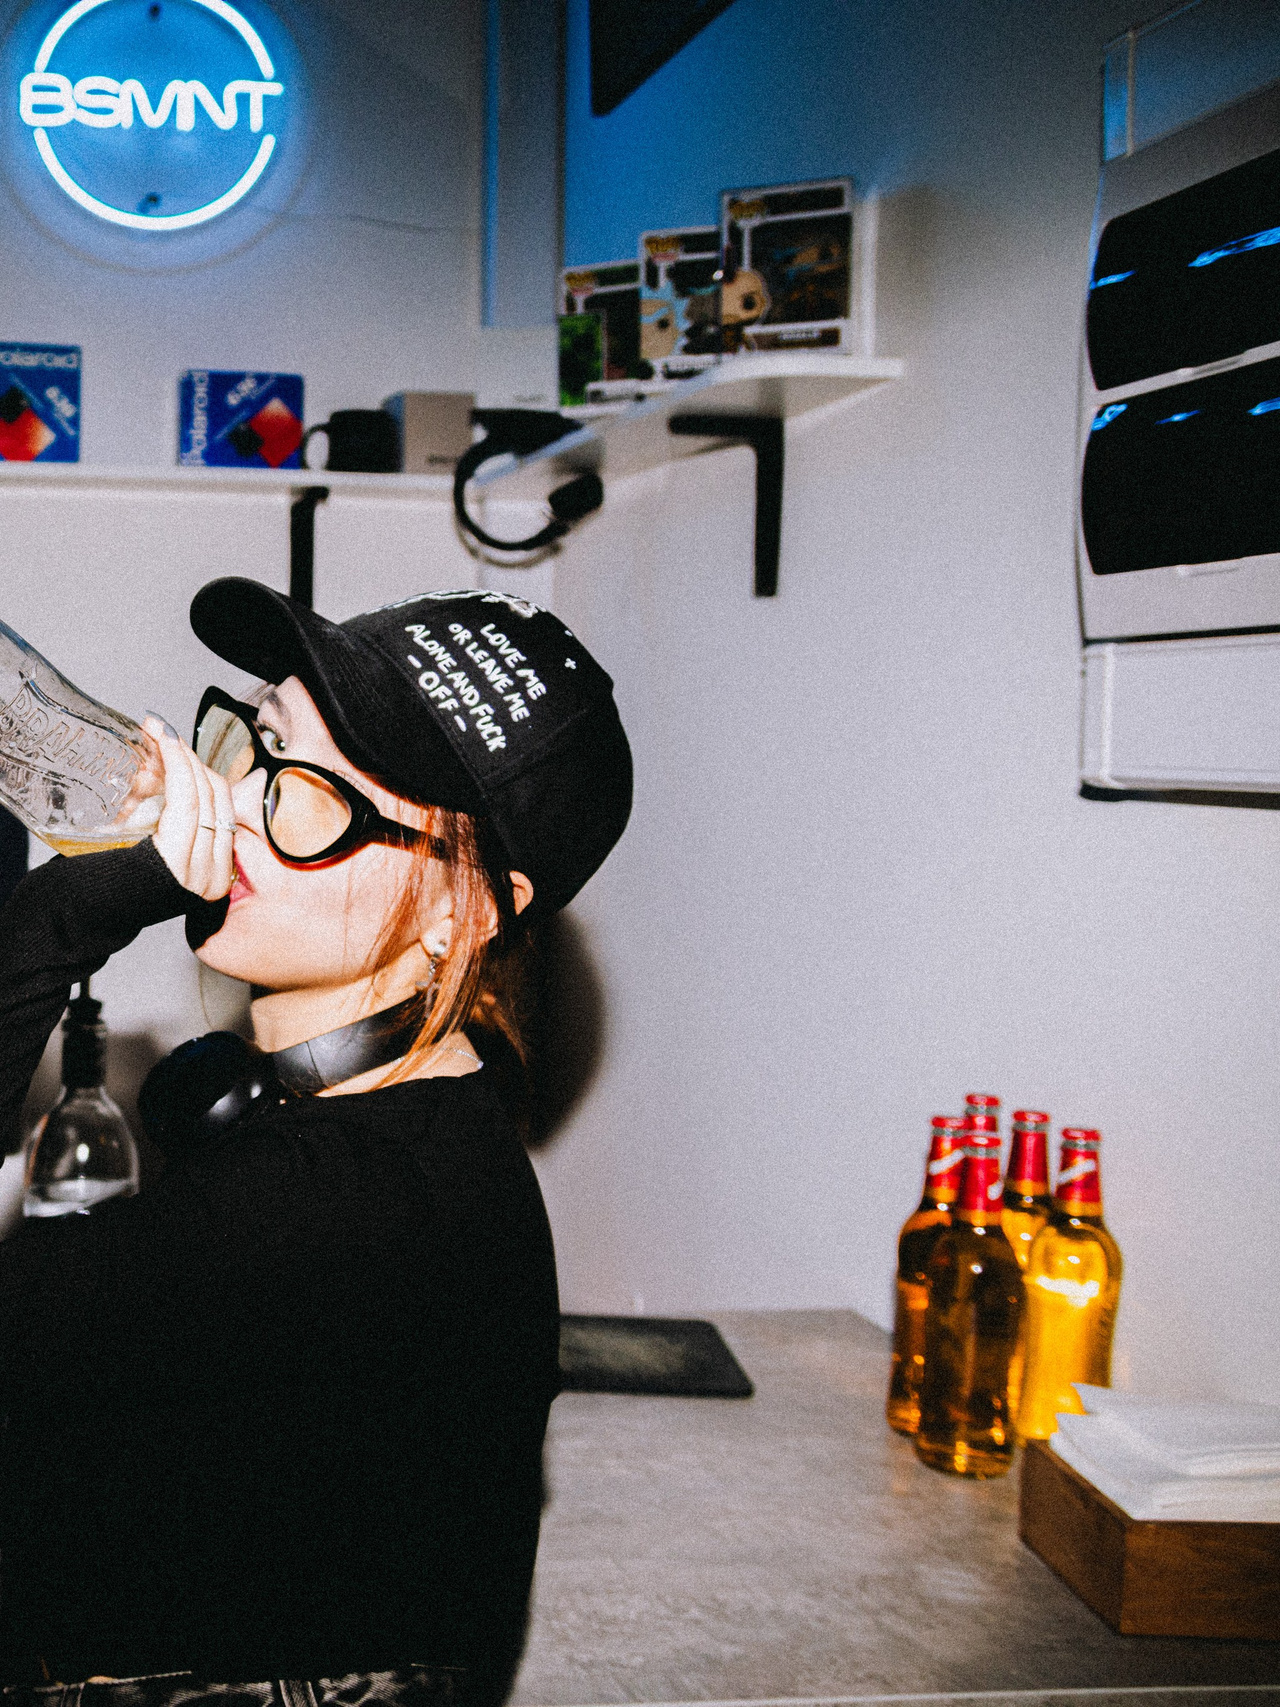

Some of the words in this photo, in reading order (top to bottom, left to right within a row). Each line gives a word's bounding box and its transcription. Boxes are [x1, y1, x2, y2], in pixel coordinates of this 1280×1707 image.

[19, 71, 284, 133] BSMNT
[187, 372, 209, 466] Polaroid
[404, 624, 458, 674] ALONE
[446, 671, 480, 707] AND
[469, 703, 507, 752] FUCK
[448, 623, 473, 646] OR
[465, 642, 515, 694] LEAVE
[503, 692, 531, 723] ME
[480, 623, 527, 669] LOVE
[515, 668, 547, 701] ME
